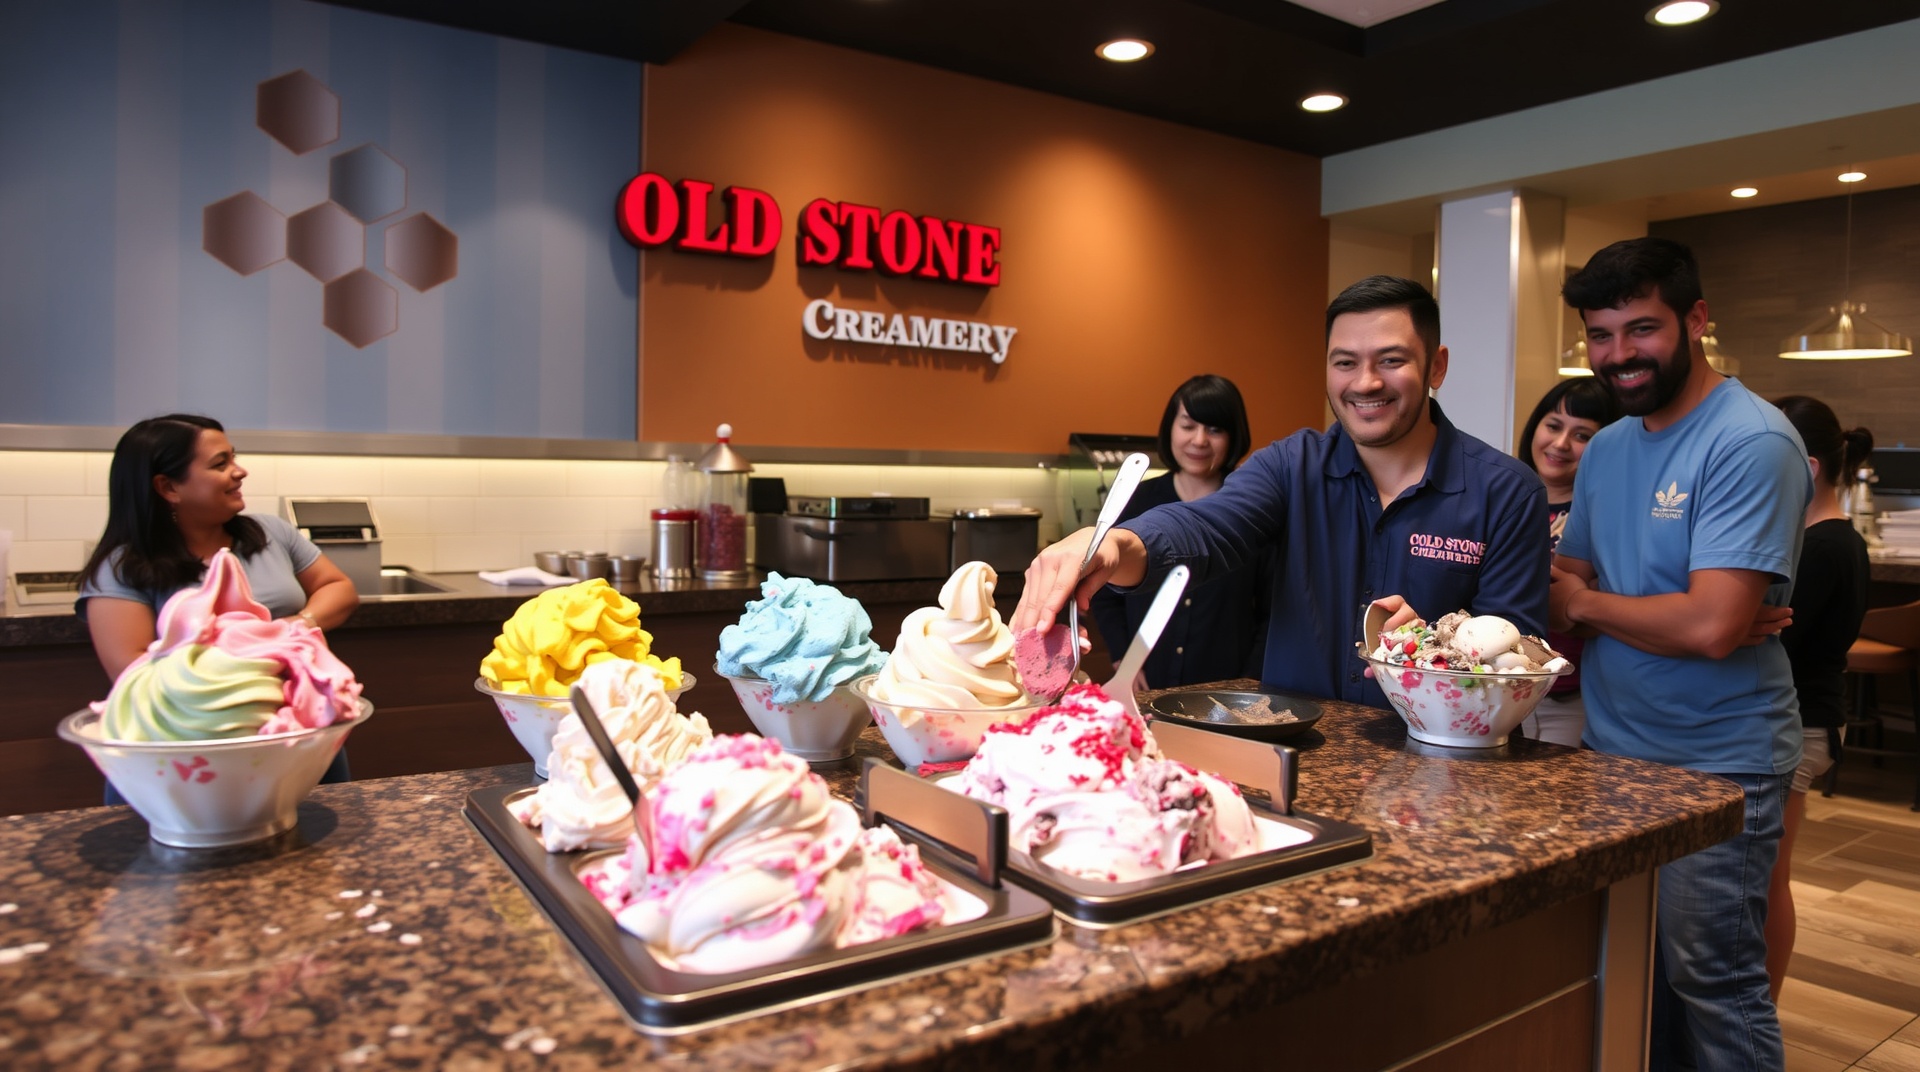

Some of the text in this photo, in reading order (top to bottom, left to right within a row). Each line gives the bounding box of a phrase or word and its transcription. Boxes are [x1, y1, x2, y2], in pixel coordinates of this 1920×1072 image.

[617, 172, 1001, 286] OLD STONE
[1410, 533, 1443, 549] COLD
